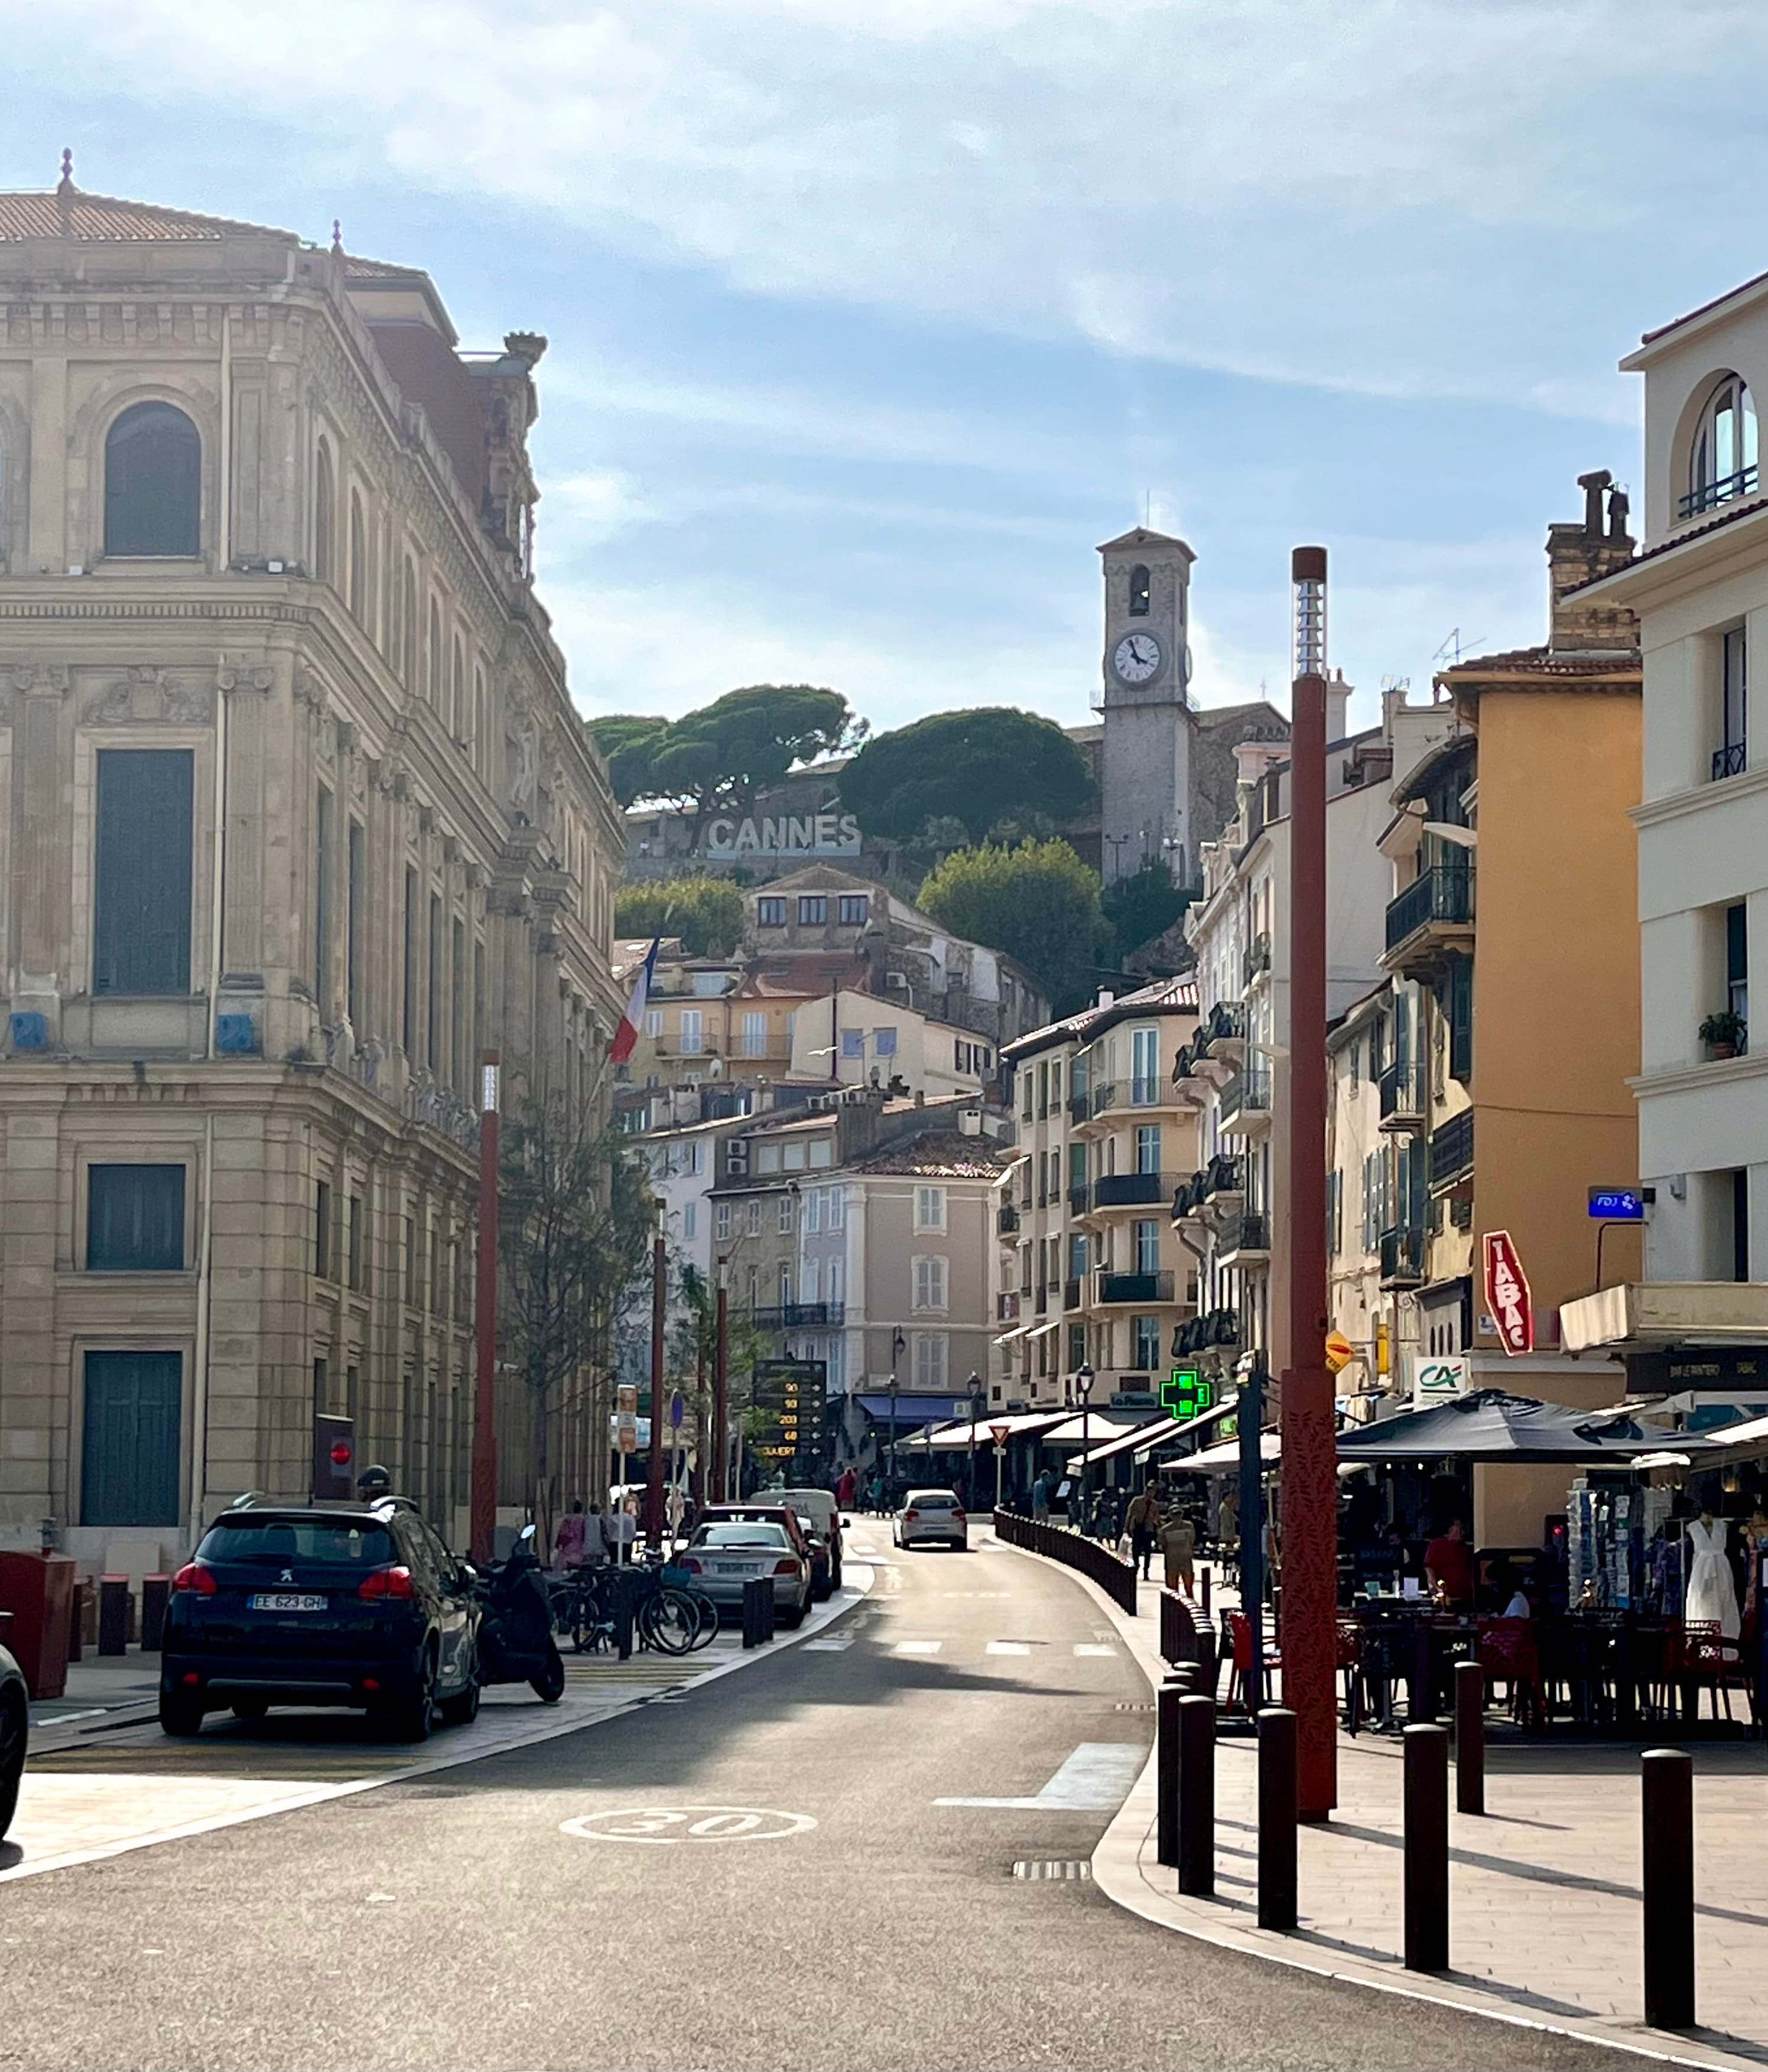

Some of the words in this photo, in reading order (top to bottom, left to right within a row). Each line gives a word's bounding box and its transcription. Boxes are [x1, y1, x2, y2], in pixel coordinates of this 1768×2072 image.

[709, 814, 863, 851] CANNES
[1597, 1197, 1618, 1206] FDJ
[1491, 1240, 1525, 1347] TABAC
[608, 1811, 763, 1833] 30
